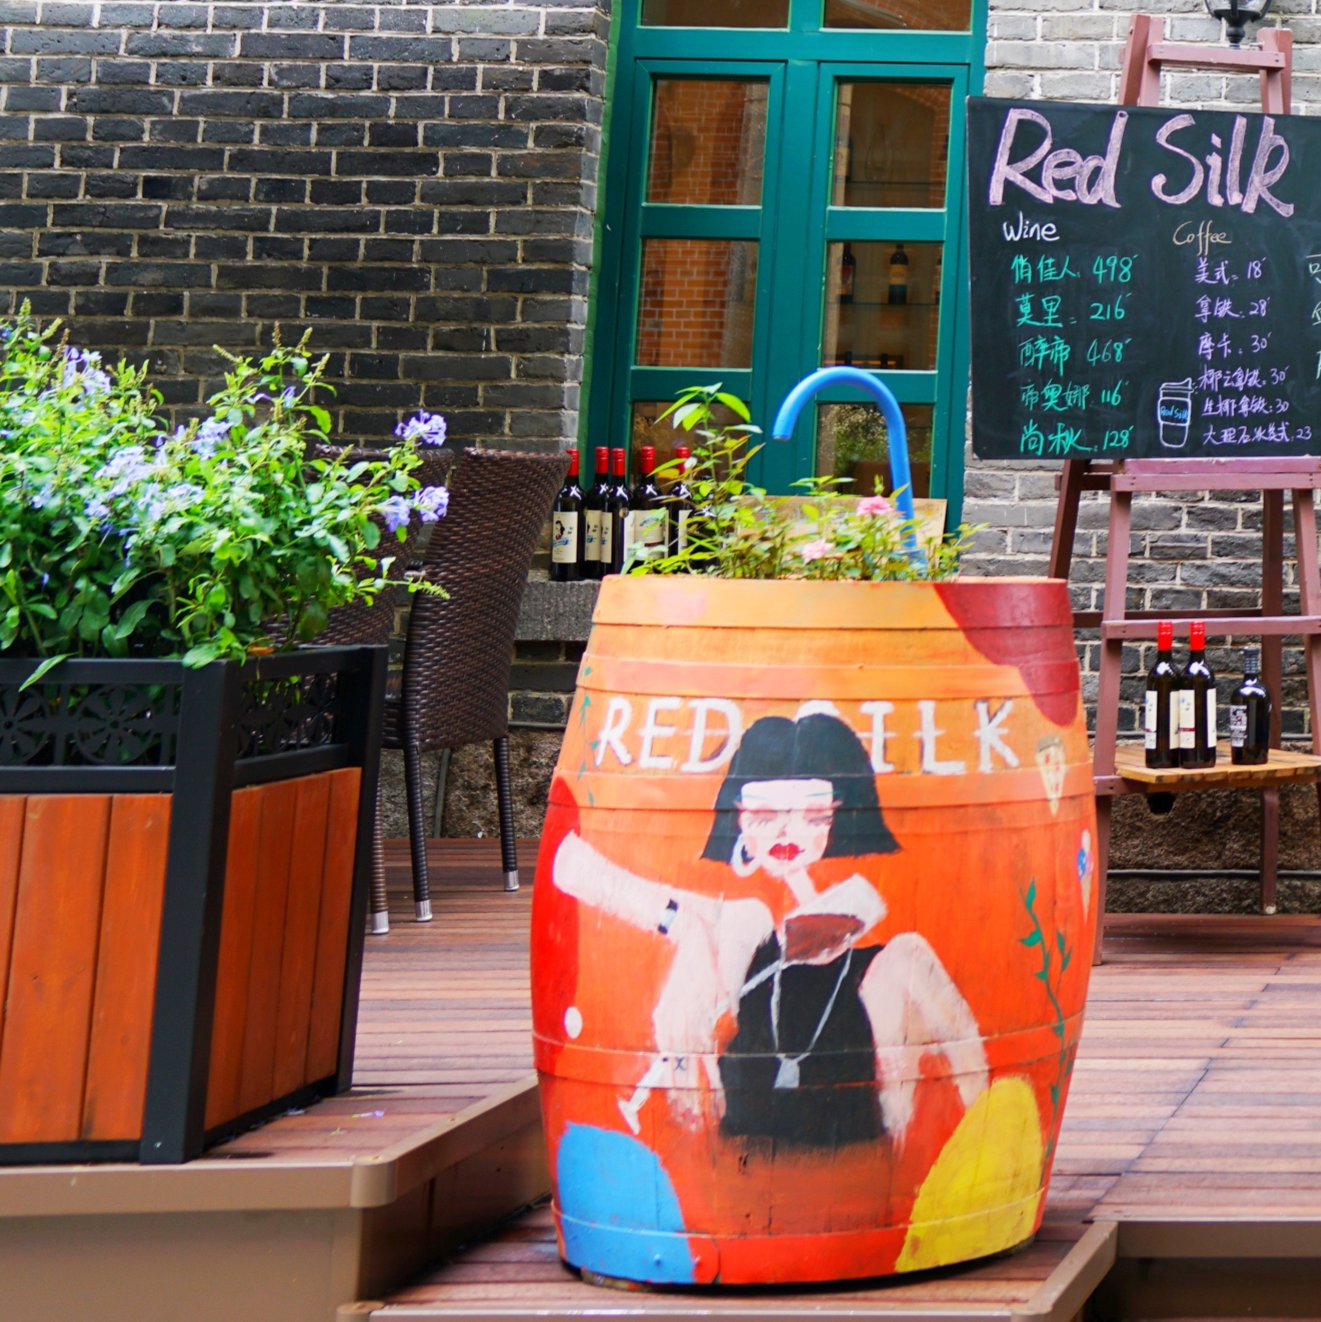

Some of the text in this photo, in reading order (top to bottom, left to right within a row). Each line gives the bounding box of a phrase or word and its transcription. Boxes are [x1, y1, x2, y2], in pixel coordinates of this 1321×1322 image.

[989, 108, 1295, 218] Red Silk
[1003, 211, 1060, 241] Wine
[1173, 220, 1232, 256] Coffee
[596, 696, 742, 773] RED
